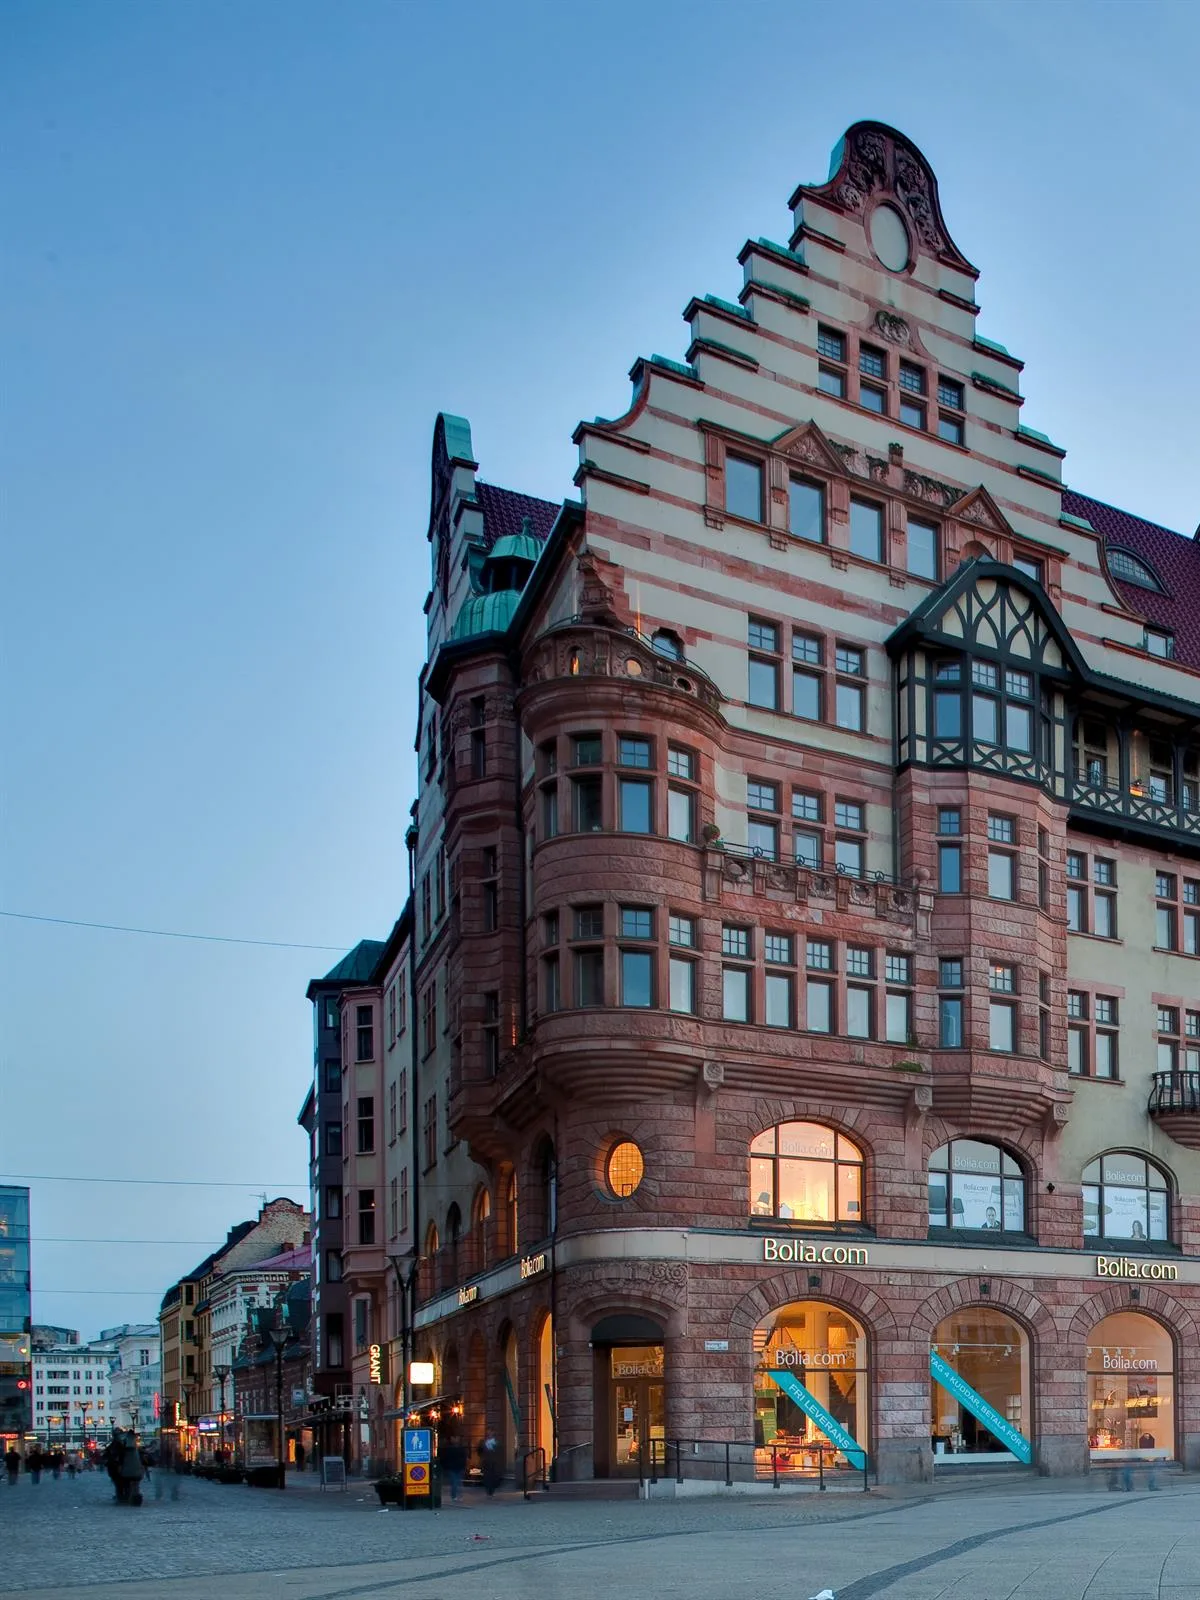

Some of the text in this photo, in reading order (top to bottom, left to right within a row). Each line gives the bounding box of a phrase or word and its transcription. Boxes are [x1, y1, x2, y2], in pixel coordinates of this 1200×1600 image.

[954, 1155, 999, 1170] Bolia.com
[1105, 1170, 1145, 1182] Bolia.com
[763, 1238, 869, 1265] Bolia.com
[1096, 1255, 1178, 1280] Bolia.com
[370, 1344, 381, 1385] GRANIT
[775, 1350, 846, 1366] Bolia.com
[1103, 1355, 1158, 1370] Bolia.com
[930, 1357, 944, 1372] TAG
[950, 1376, 980, 1409] KUDDAR,
[981, 1405, 1006, 1432] BETALA
[1006, 1430, 1022, 1447] FÖR
[788, 1384, 850, 1449] FRI LEVERANS
